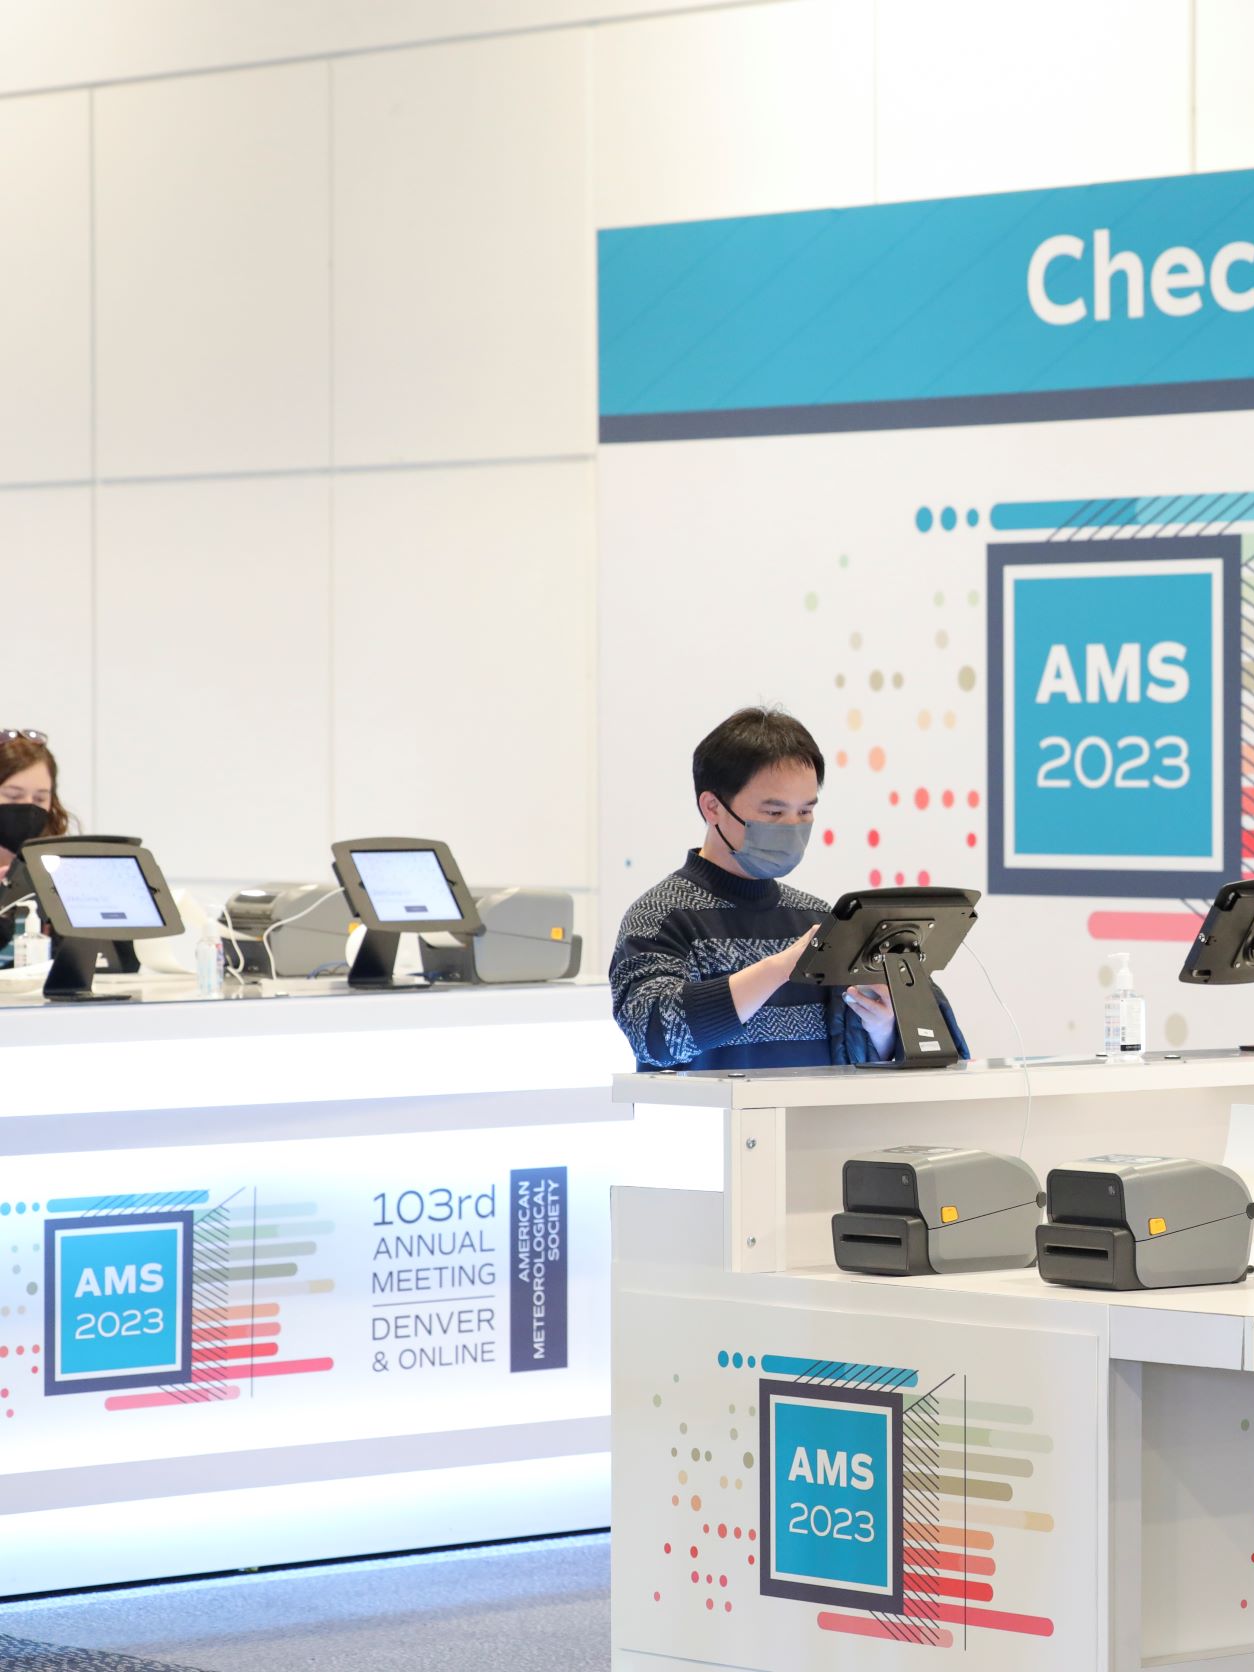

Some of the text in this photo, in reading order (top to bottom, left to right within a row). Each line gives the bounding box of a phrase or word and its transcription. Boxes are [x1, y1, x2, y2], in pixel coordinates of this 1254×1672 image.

[1035, 640, 1190, 704] AMS
[1036, 735, 1191, 789] 2023
[373, 1183, 496, 1227] 103rd
[547, 1179, 560, 1261] SOCIETY
[373, 1230, 495, 1261] ANNUAL
[518, 1180, 531, 1283] AMERICAN
[74, 1262, 164, 1298] AMS
[372, 1263, 496, 1294] MEETING
[532, 1179, 546, 1360] METEOROLOGICAL
[74, 1307, 164, 1340] 2023
[372, 1308, 495, 1341] DENVER
[371, 1341, 495, 1372] & ONLINE
[788, 1446, 875, 1491] AMS
[788, 1502, 875, 1543] 2023
